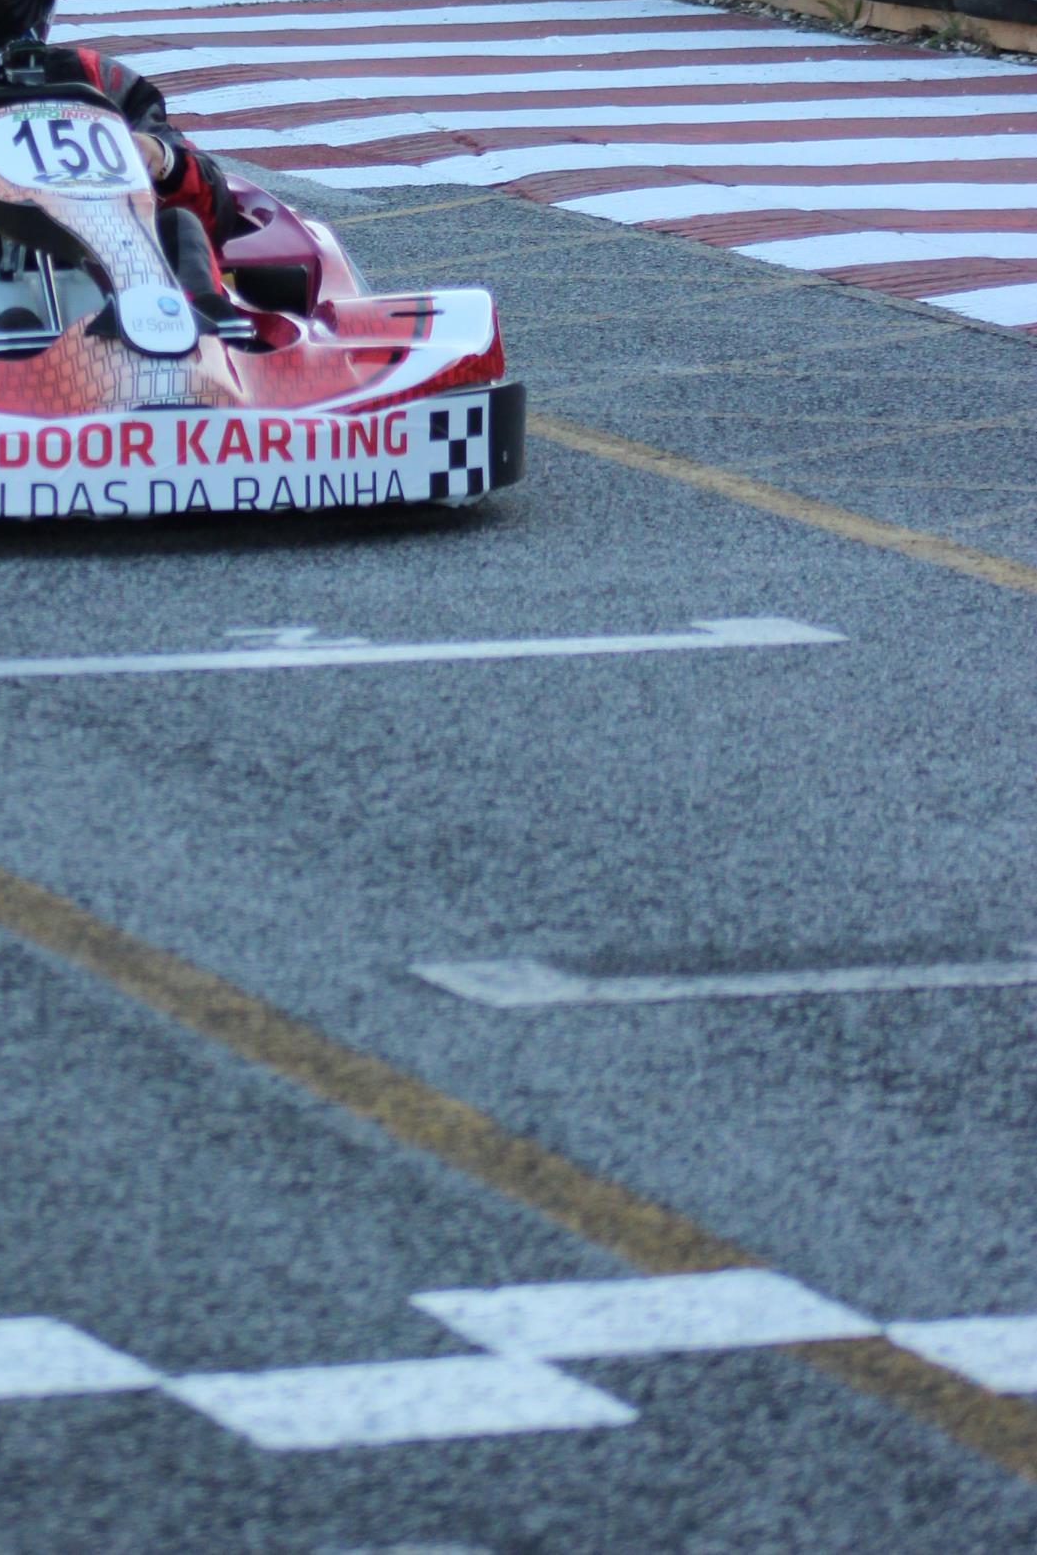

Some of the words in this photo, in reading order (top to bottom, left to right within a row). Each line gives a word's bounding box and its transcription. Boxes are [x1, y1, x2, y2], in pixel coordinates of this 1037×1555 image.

[13, 120, 127, 176] 150
[176, 410, 408, 466] KARTING
[149, 478, 212, 516] DA
[233, 469, 406, 511] RAINHA
